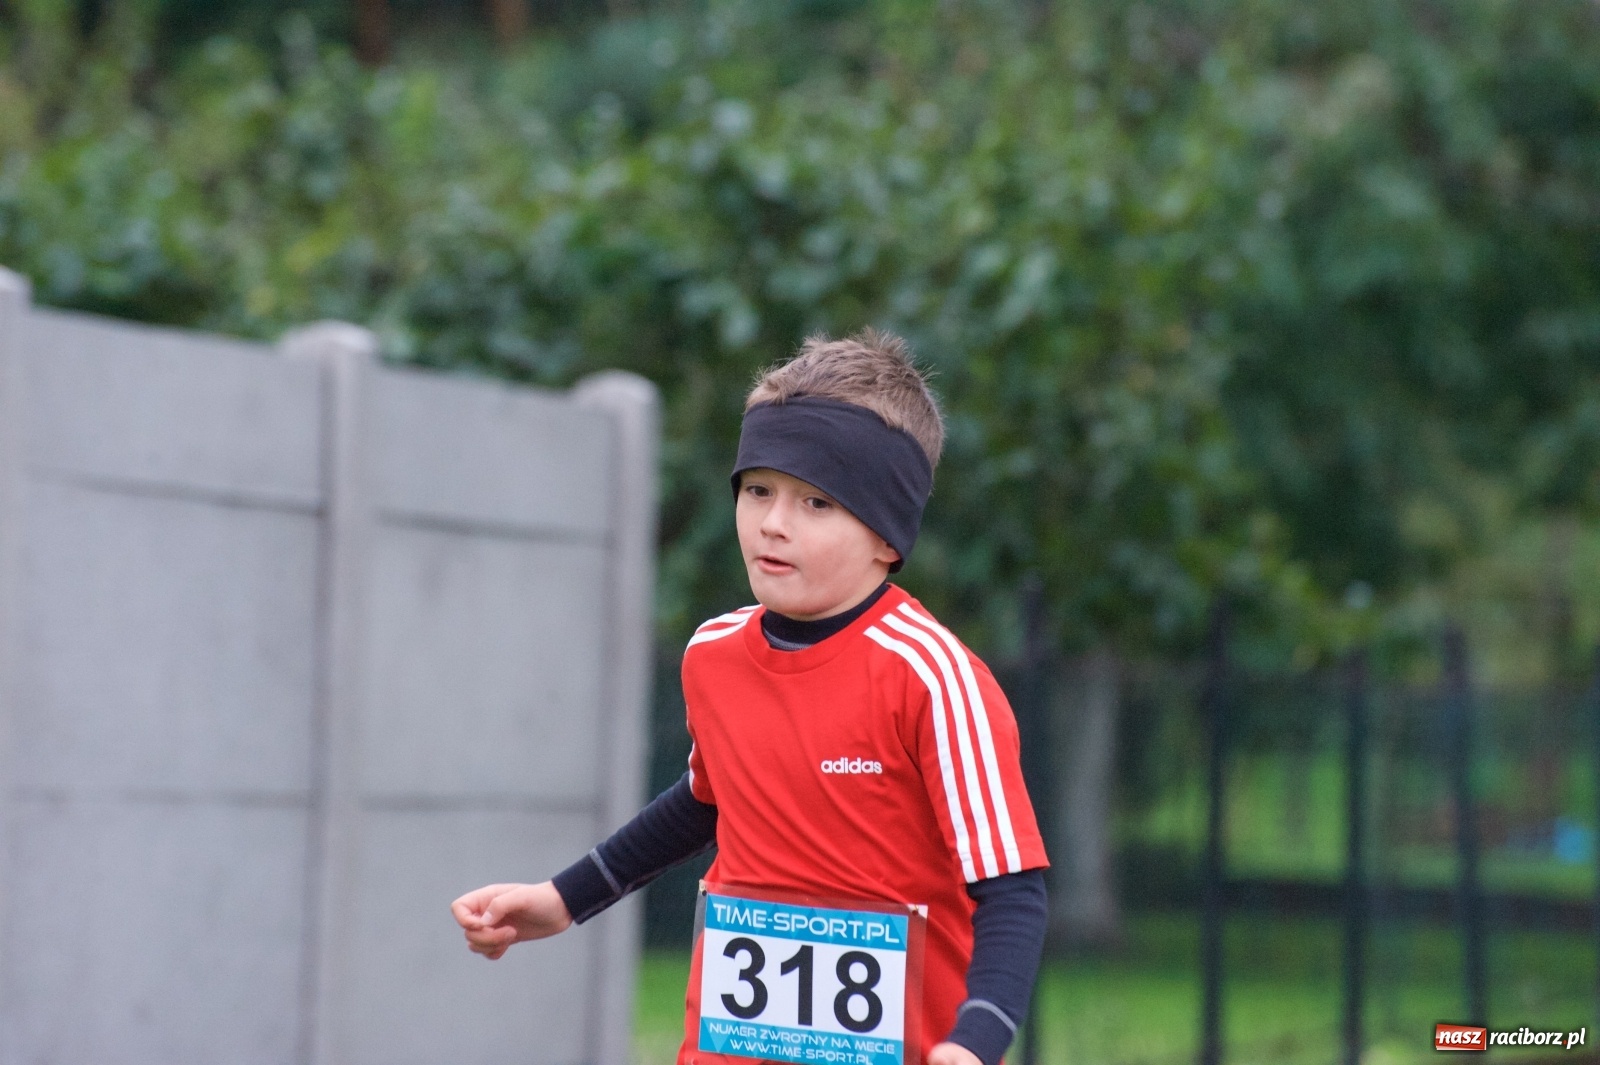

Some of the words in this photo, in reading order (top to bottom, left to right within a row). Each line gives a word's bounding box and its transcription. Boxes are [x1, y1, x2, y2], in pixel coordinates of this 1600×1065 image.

[820, 756, 883, 775] adidas
[712, 903, 900, 944] TIME-SPORT.PL
[720, 936, 883, 1034] 318
[709, 1022, 757, 1039] NUMER
[759, 1028, 828, 1047] ZWROTNY
[831, 1036, 850, 1050] NA
[854, 1041, 895, 1056] MECIE
